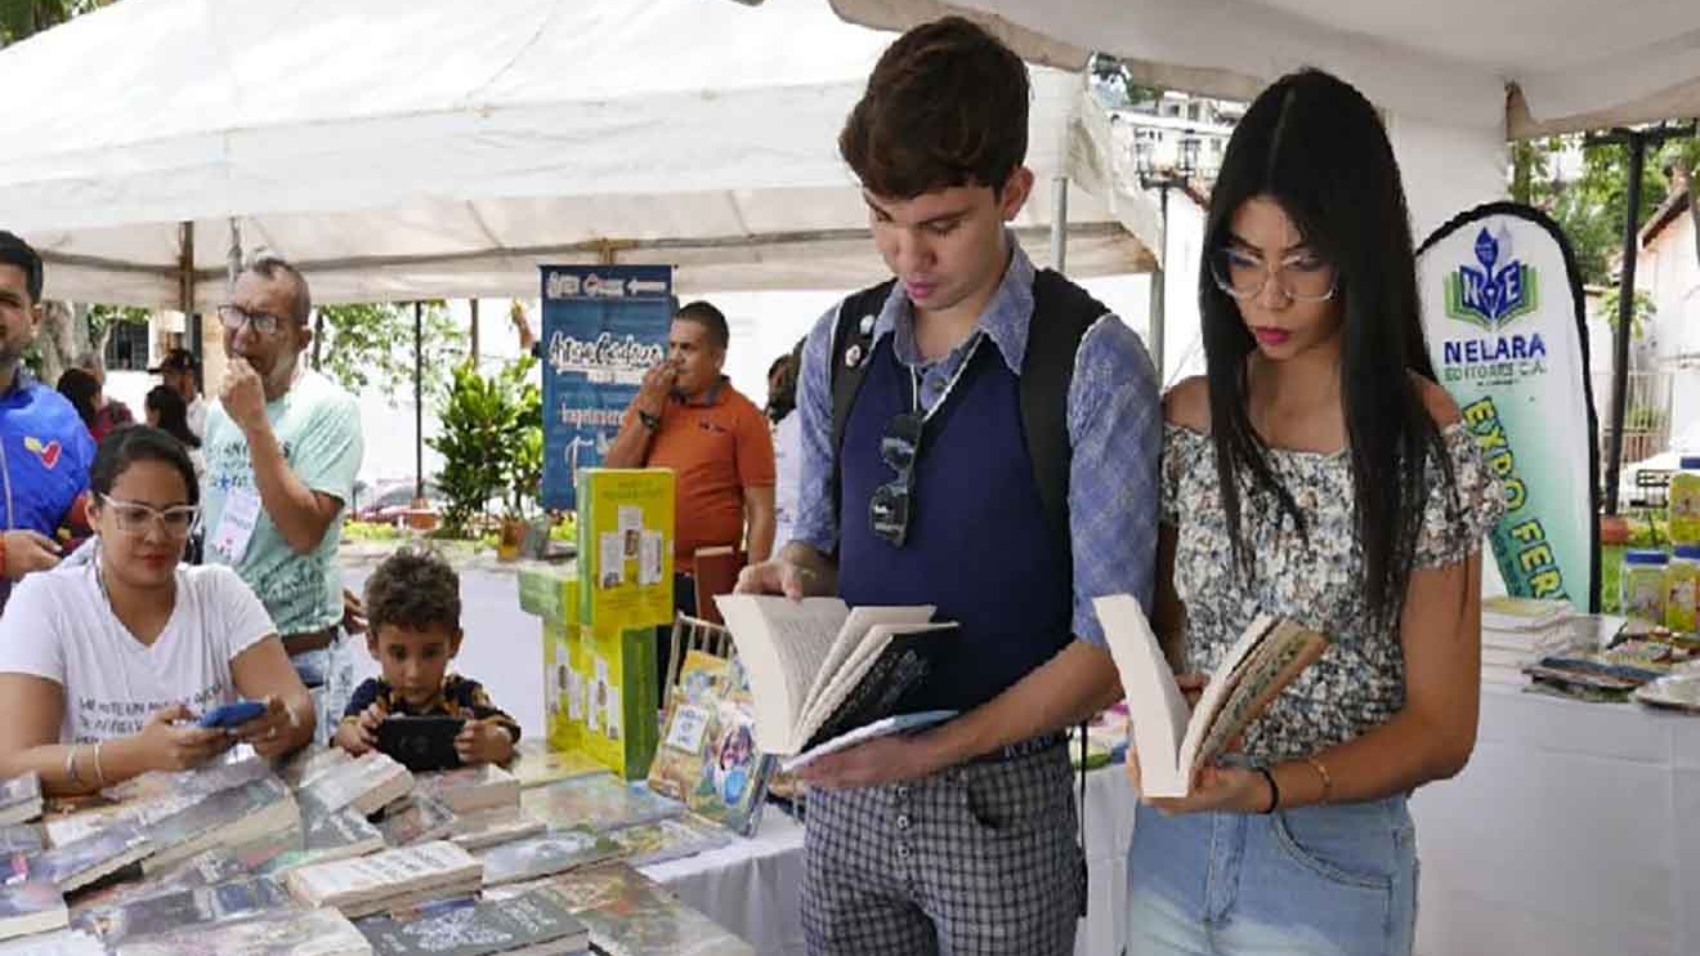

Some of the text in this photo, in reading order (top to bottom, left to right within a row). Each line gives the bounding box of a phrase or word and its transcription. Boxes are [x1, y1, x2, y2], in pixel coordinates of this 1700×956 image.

[1444, 334, 1546, 364] NELARA
[1461, 396, 1528, 512] EXPO
[1509, 517, 1572, 600] FER
